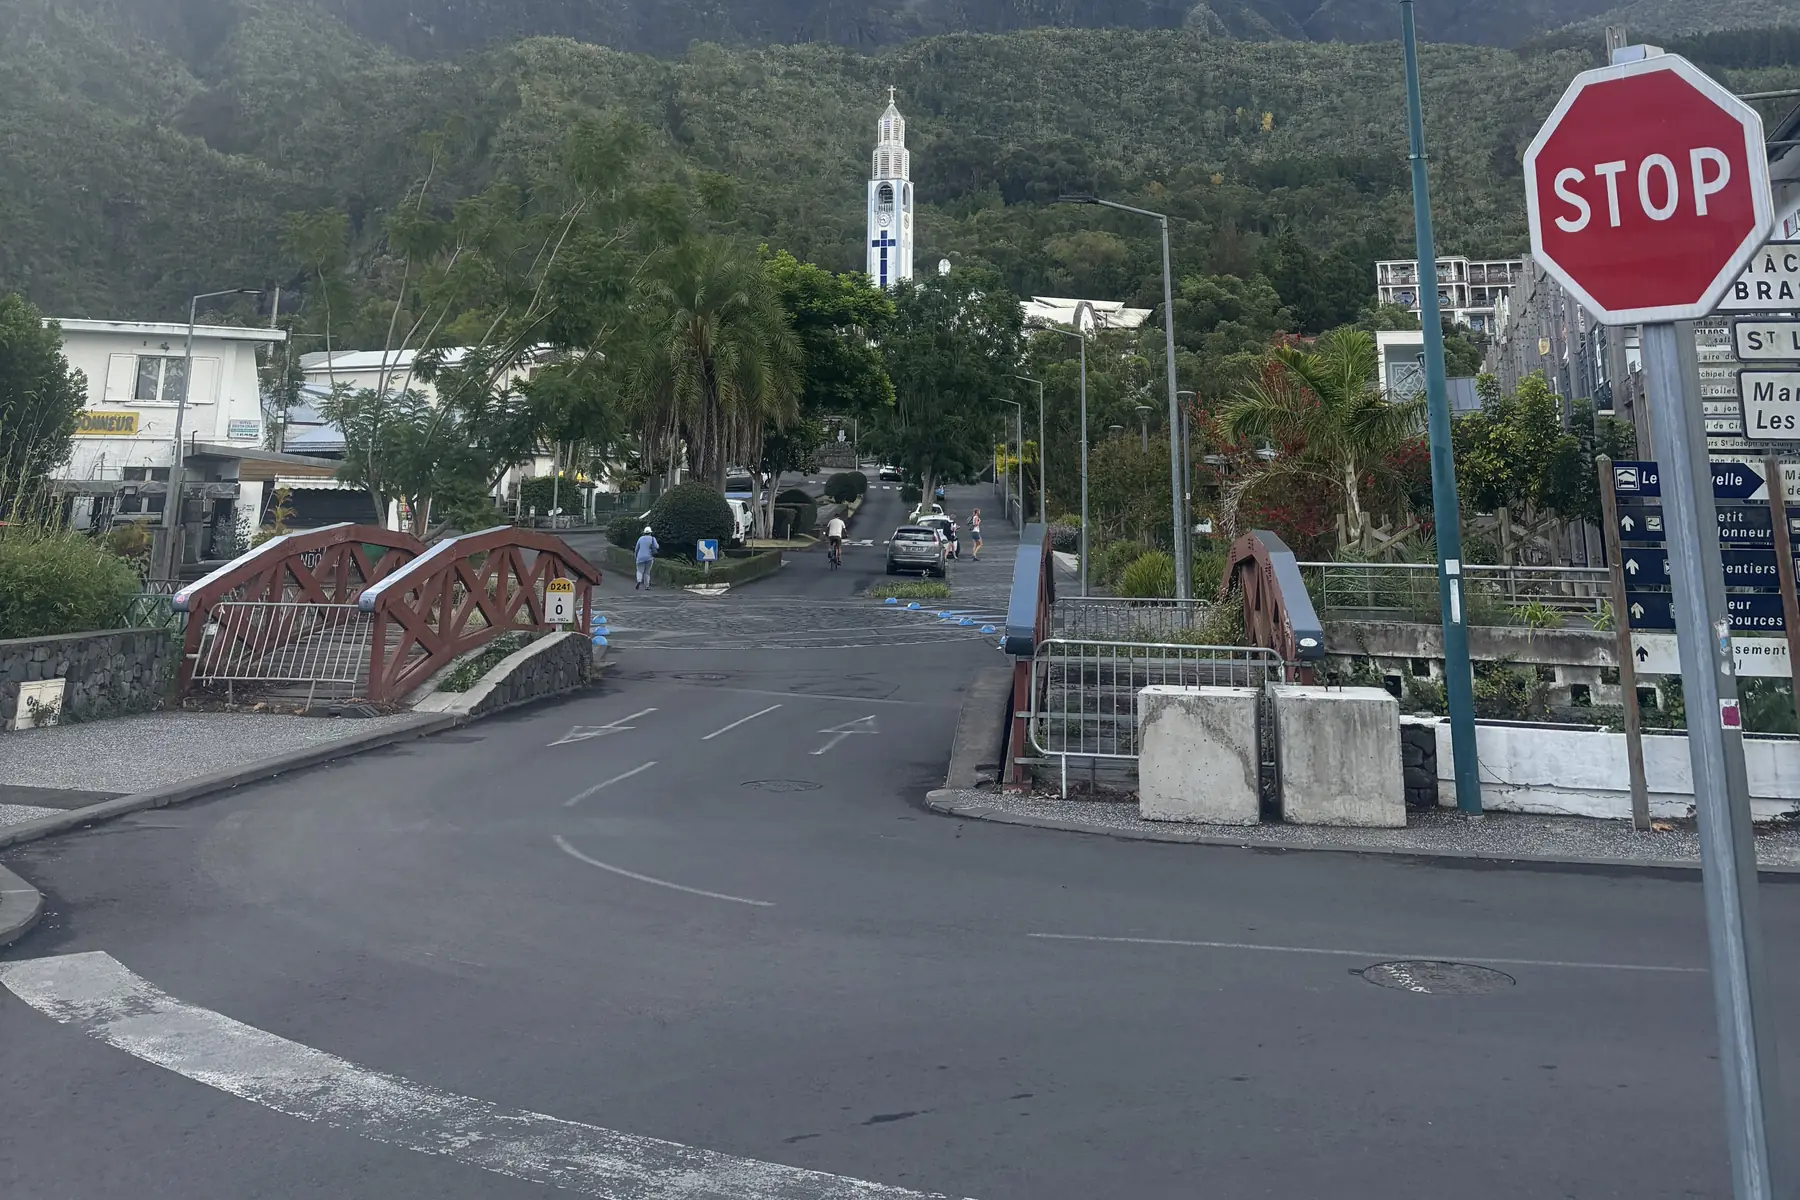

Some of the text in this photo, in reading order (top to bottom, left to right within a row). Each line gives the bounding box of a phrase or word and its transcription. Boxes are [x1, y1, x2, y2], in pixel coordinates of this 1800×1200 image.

[1554, 147, 1731, 233] STOP
[1735, 280, 1800, 300] BRA
[1699, 370, 1725, 378] chipel
[1756, 409, 1795, 429] Les
[1642, 471, 1658, 484] Le
[1727, 613, 1783, 626] Sources
